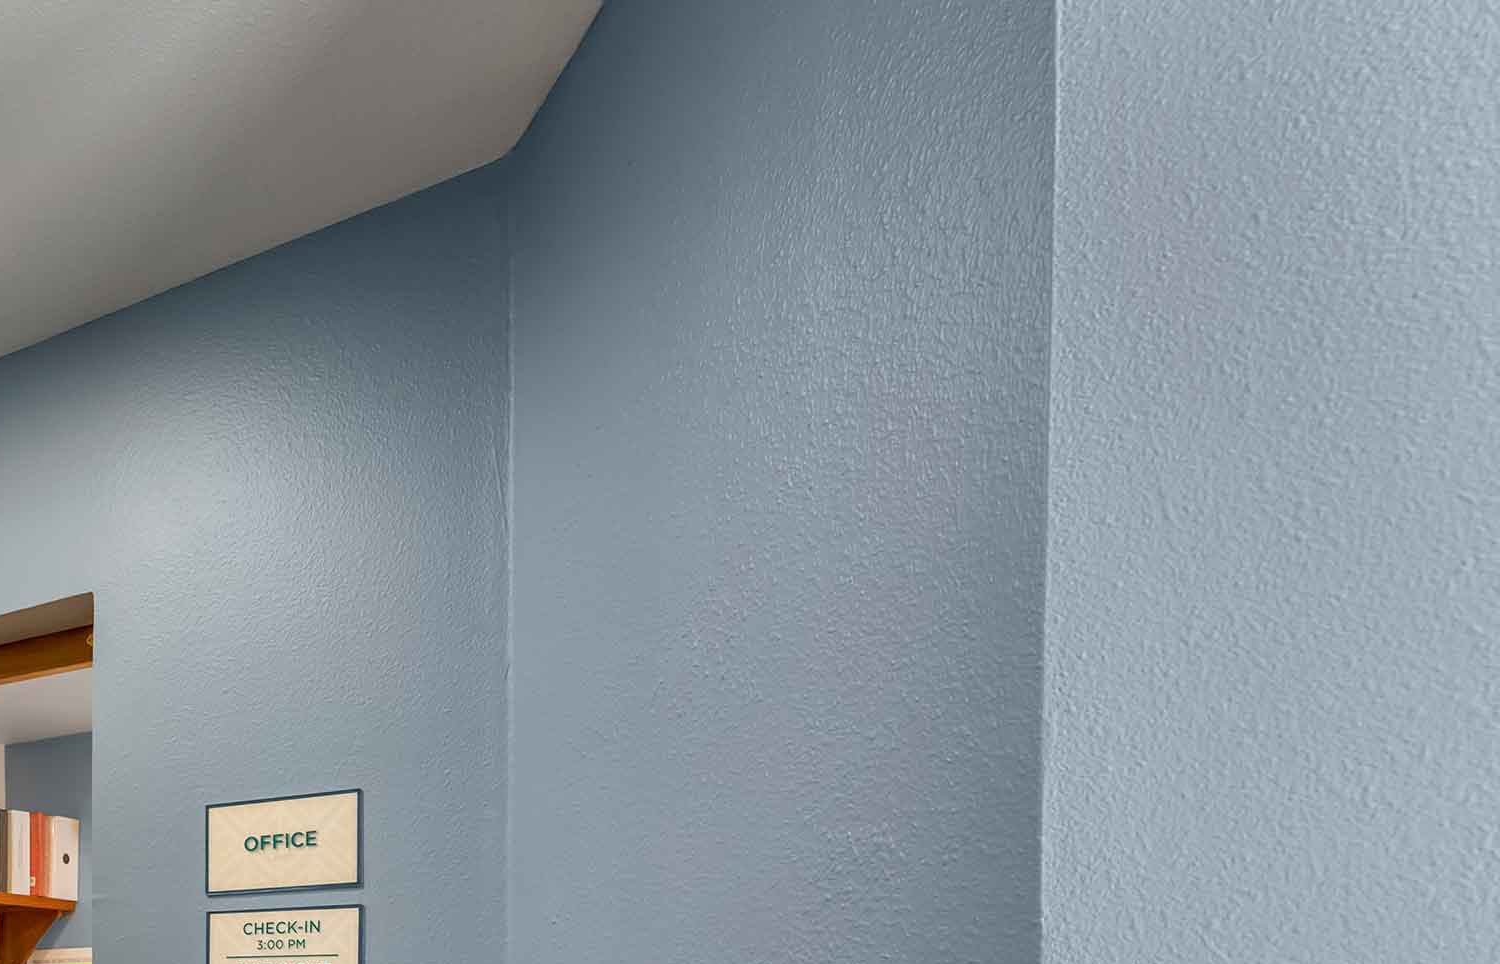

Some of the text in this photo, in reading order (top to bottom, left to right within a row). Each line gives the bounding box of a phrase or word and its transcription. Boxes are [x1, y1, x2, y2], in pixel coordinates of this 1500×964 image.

[244, 830, 318, 852] OFFICE
[243, 920, 321, 936] CHECK-IN
[256, 938, 306, 950] 3:00 PM
